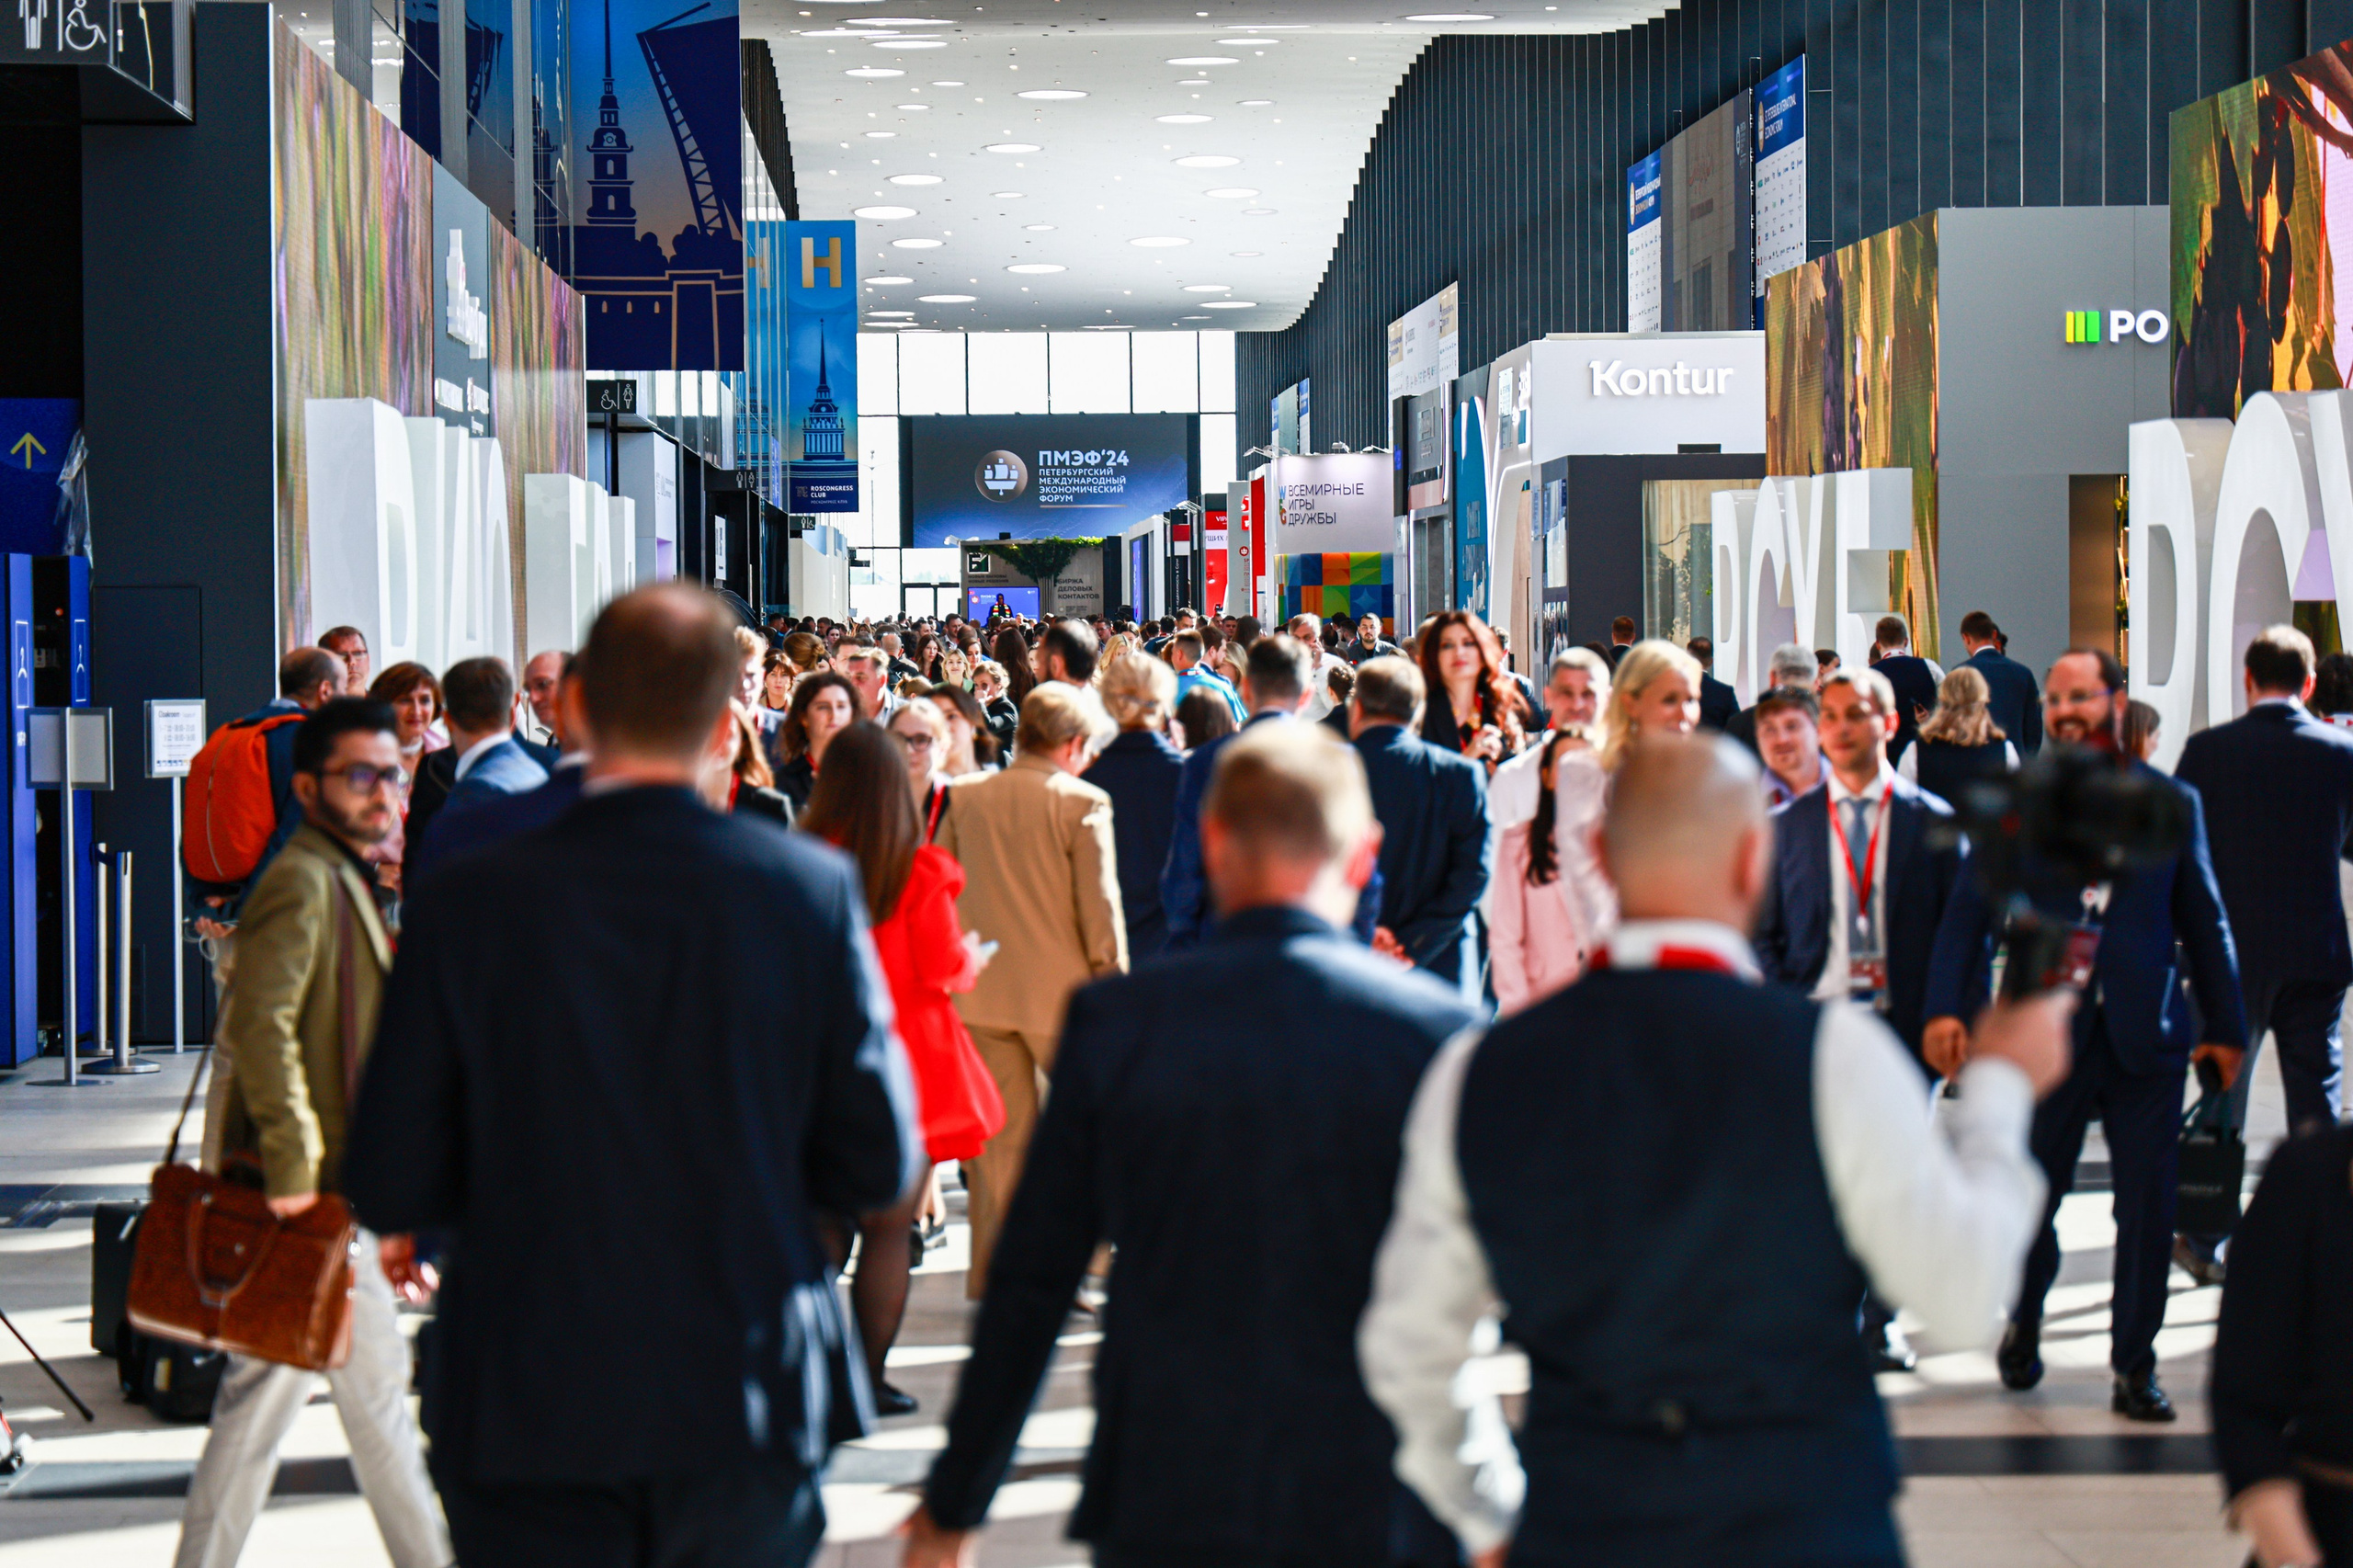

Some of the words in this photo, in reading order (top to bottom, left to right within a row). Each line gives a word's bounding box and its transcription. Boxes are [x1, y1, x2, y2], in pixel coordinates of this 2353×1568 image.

[1588, 359, 1734, 396] Kontur
[1039, 449, 1130, 466] ПМЭФ'24
[1039, 466, 1114, 476] ПЕТЕРБУРГСКИЙ
[1039, 475, 1126, 485] МЕЖДУНАРОДНЫЙ
[1039, 484, 1124, 494] ЭКОНОМИЧЕСКИЙ
[1289, 483, 1364, 496] ВСЕМИРНЫЕ
[1039, 494, 1074, 503] ФОРУМ
[1289, 498, 1314, 510] ИГРЫ
[1289, 512, 1336, 527] ДРУЖБЫ
